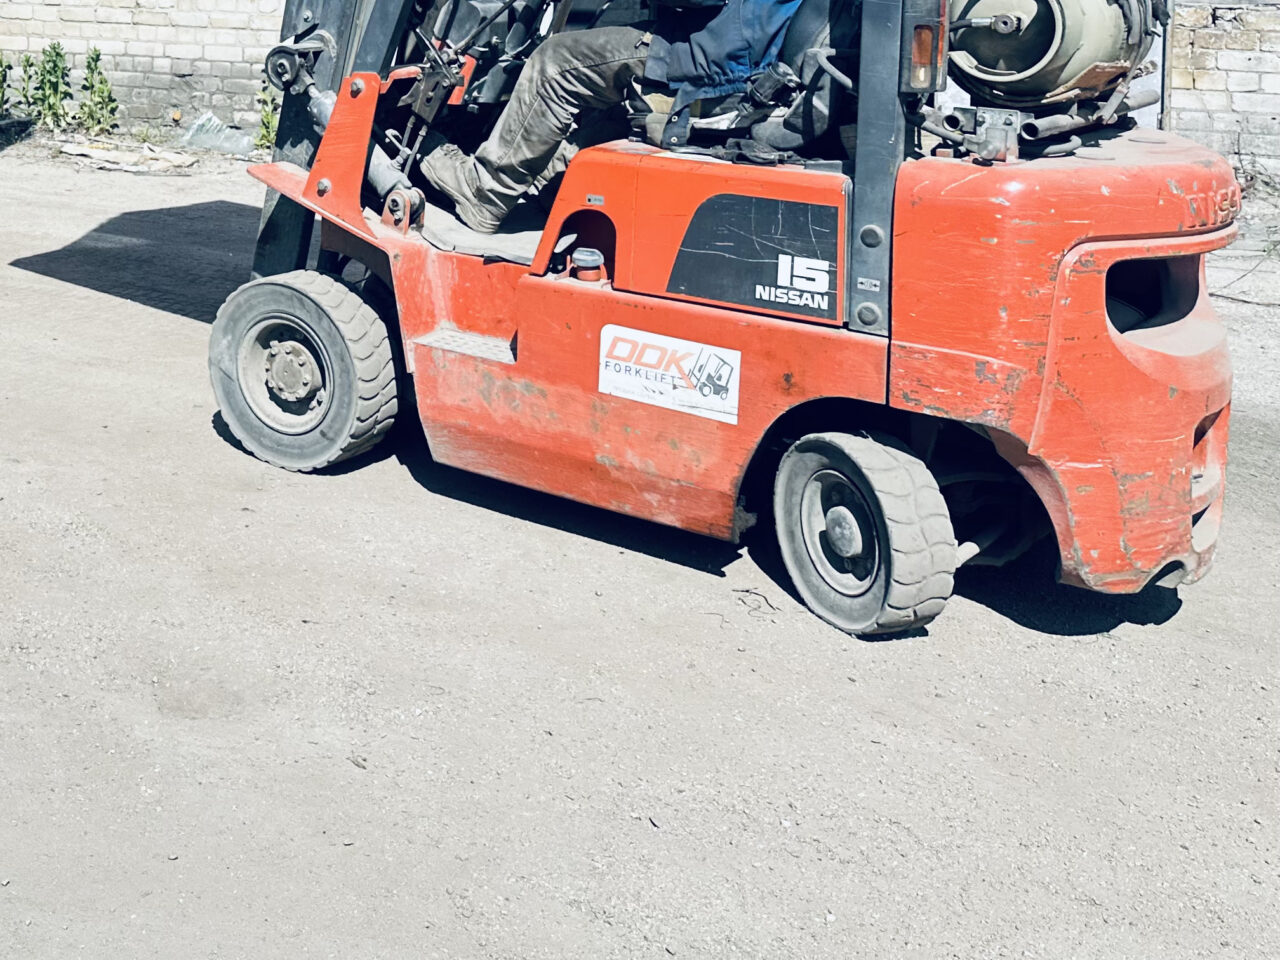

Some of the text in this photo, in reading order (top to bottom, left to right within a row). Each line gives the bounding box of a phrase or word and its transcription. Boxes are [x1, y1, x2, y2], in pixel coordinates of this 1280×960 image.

[777, 253, 830, 293] 15
[755, 284, 829, 310] NISSAN
[604, 360, 677, 386] FORKLIFT
[605, 335, 697, 391] DDK
